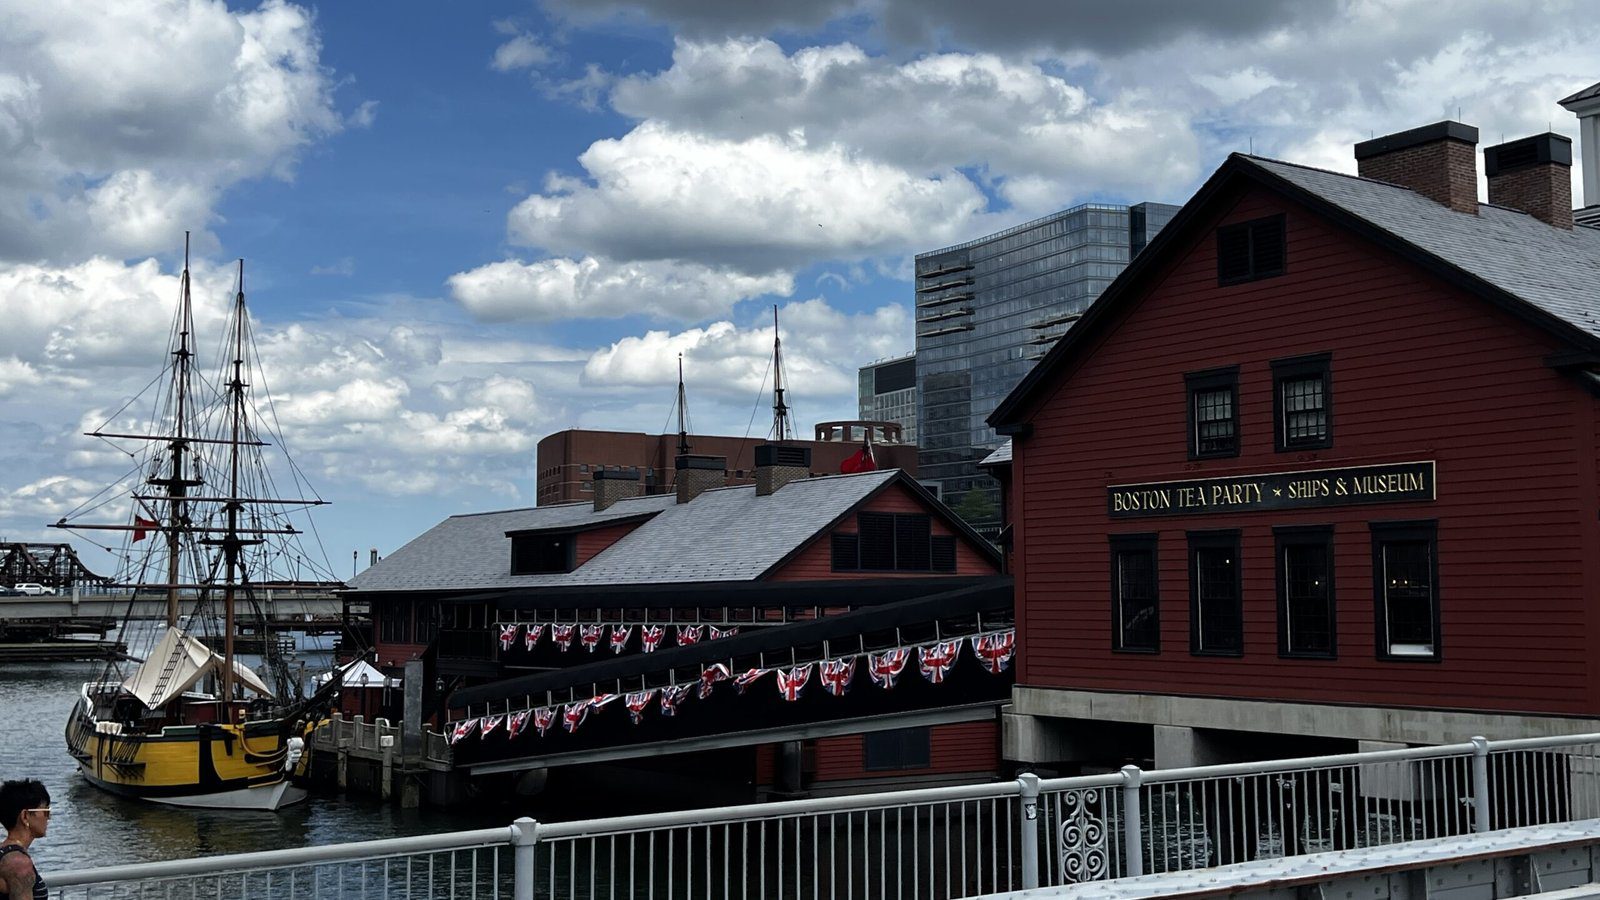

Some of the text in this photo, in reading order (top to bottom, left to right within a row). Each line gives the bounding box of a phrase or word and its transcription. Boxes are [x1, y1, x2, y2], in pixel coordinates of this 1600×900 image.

[1113, 472, 1425, 511] BOSTON TEA PARTY SHIPS & MUSEUM
